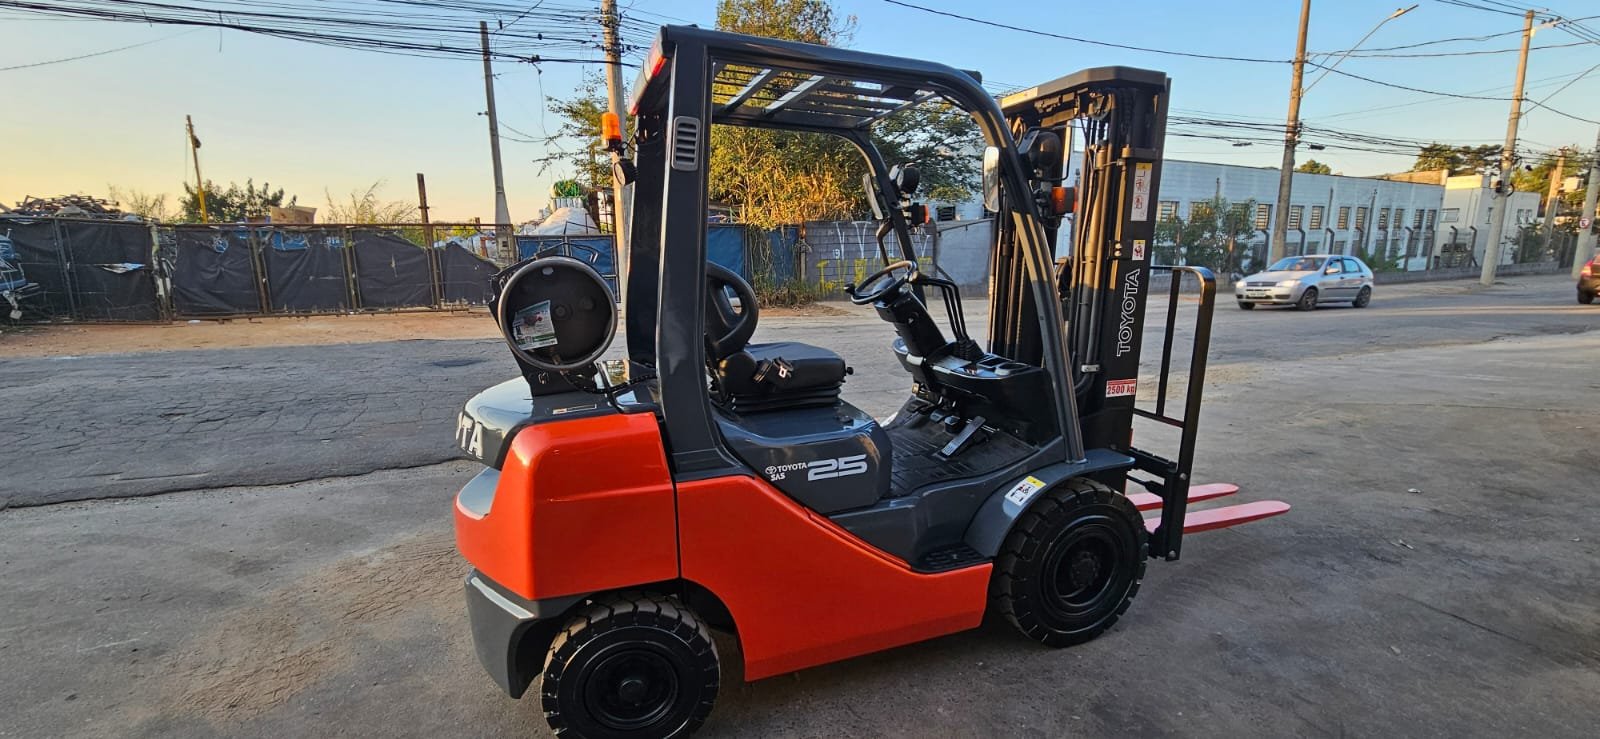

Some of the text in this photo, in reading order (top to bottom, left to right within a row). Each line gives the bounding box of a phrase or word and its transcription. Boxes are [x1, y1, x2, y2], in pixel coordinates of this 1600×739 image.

[1117, 268, 1140, 356] TOYOTA
[1107, 385, 1124, 395] 2500
[777, 462, 807, 472] TOYOTA
[807, 454, 868, 481] 25
[771, 472, 785, 482] SAS
